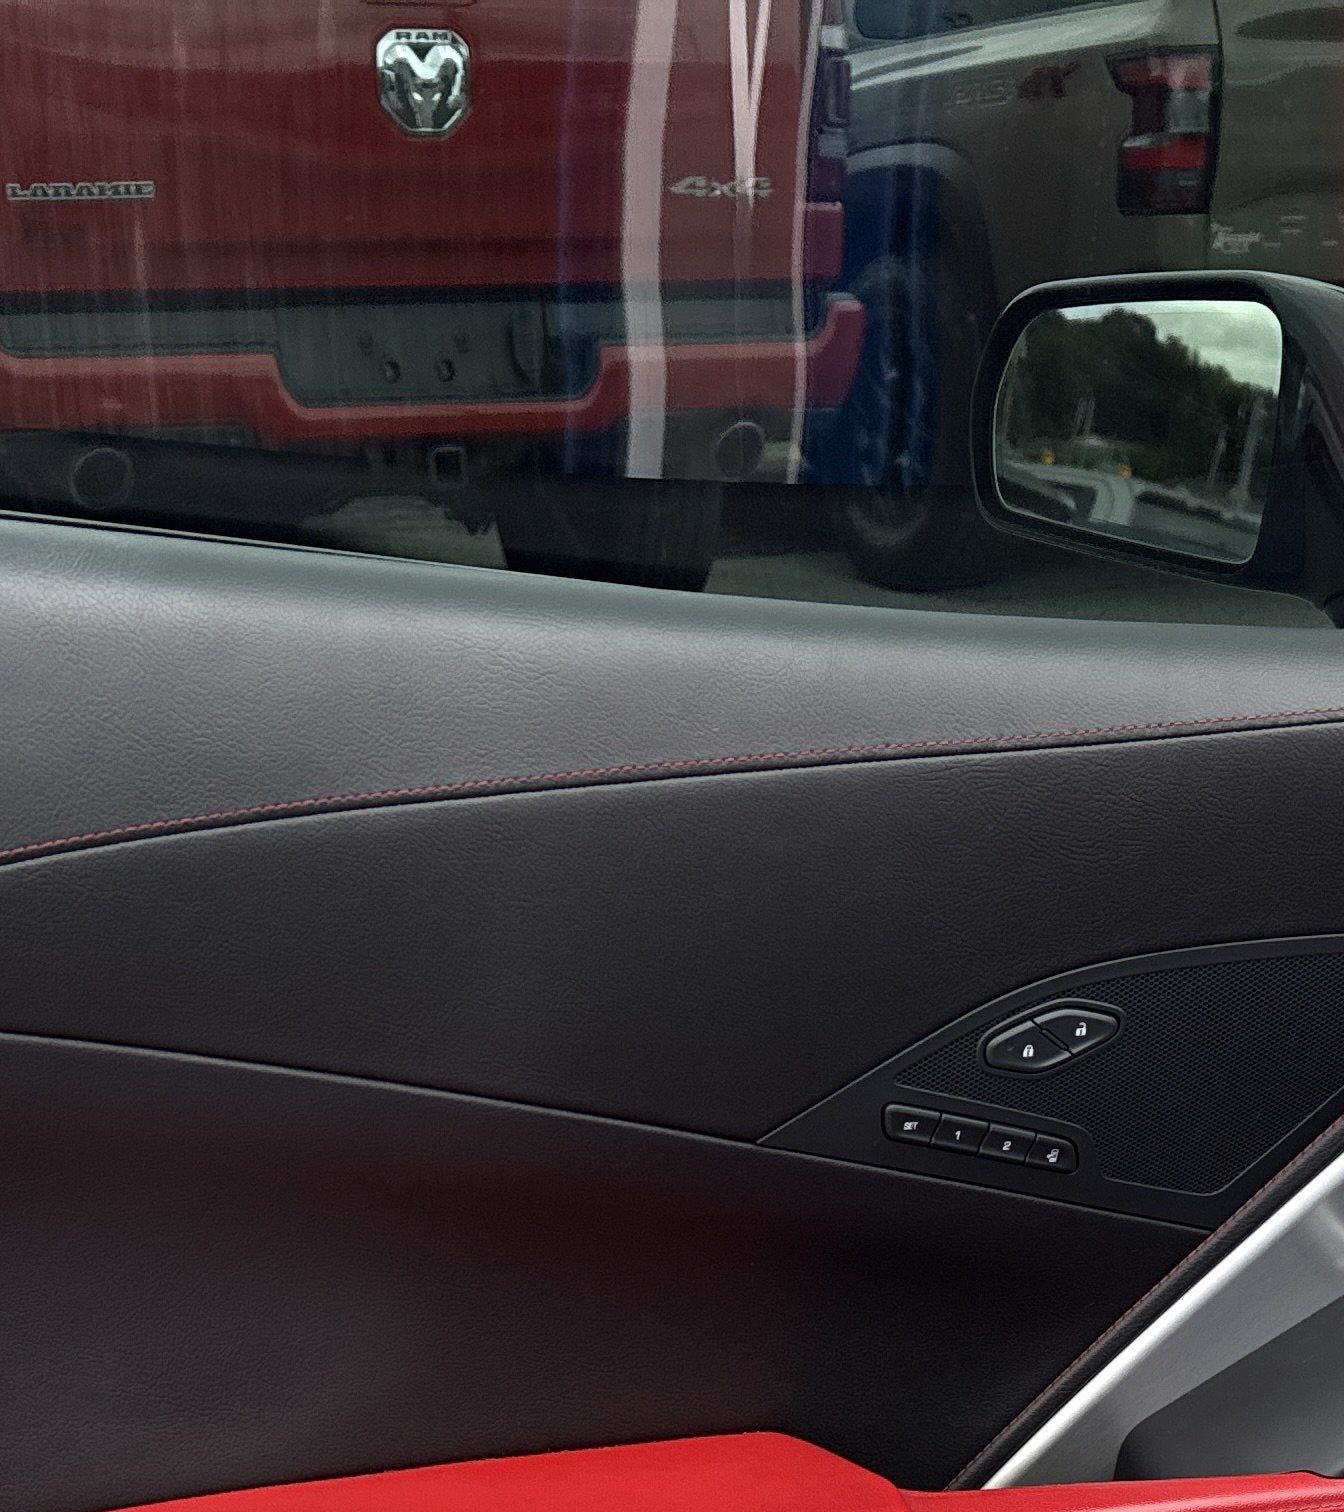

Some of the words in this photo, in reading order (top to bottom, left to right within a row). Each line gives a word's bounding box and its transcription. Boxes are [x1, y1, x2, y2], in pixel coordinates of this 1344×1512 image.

[395, 31, 449, 41] RAM
[903, 1121, 918, 1131] SET
[955, 1130, 961, 1141] 1
[1002, 1140, 1012, 1151] 2
